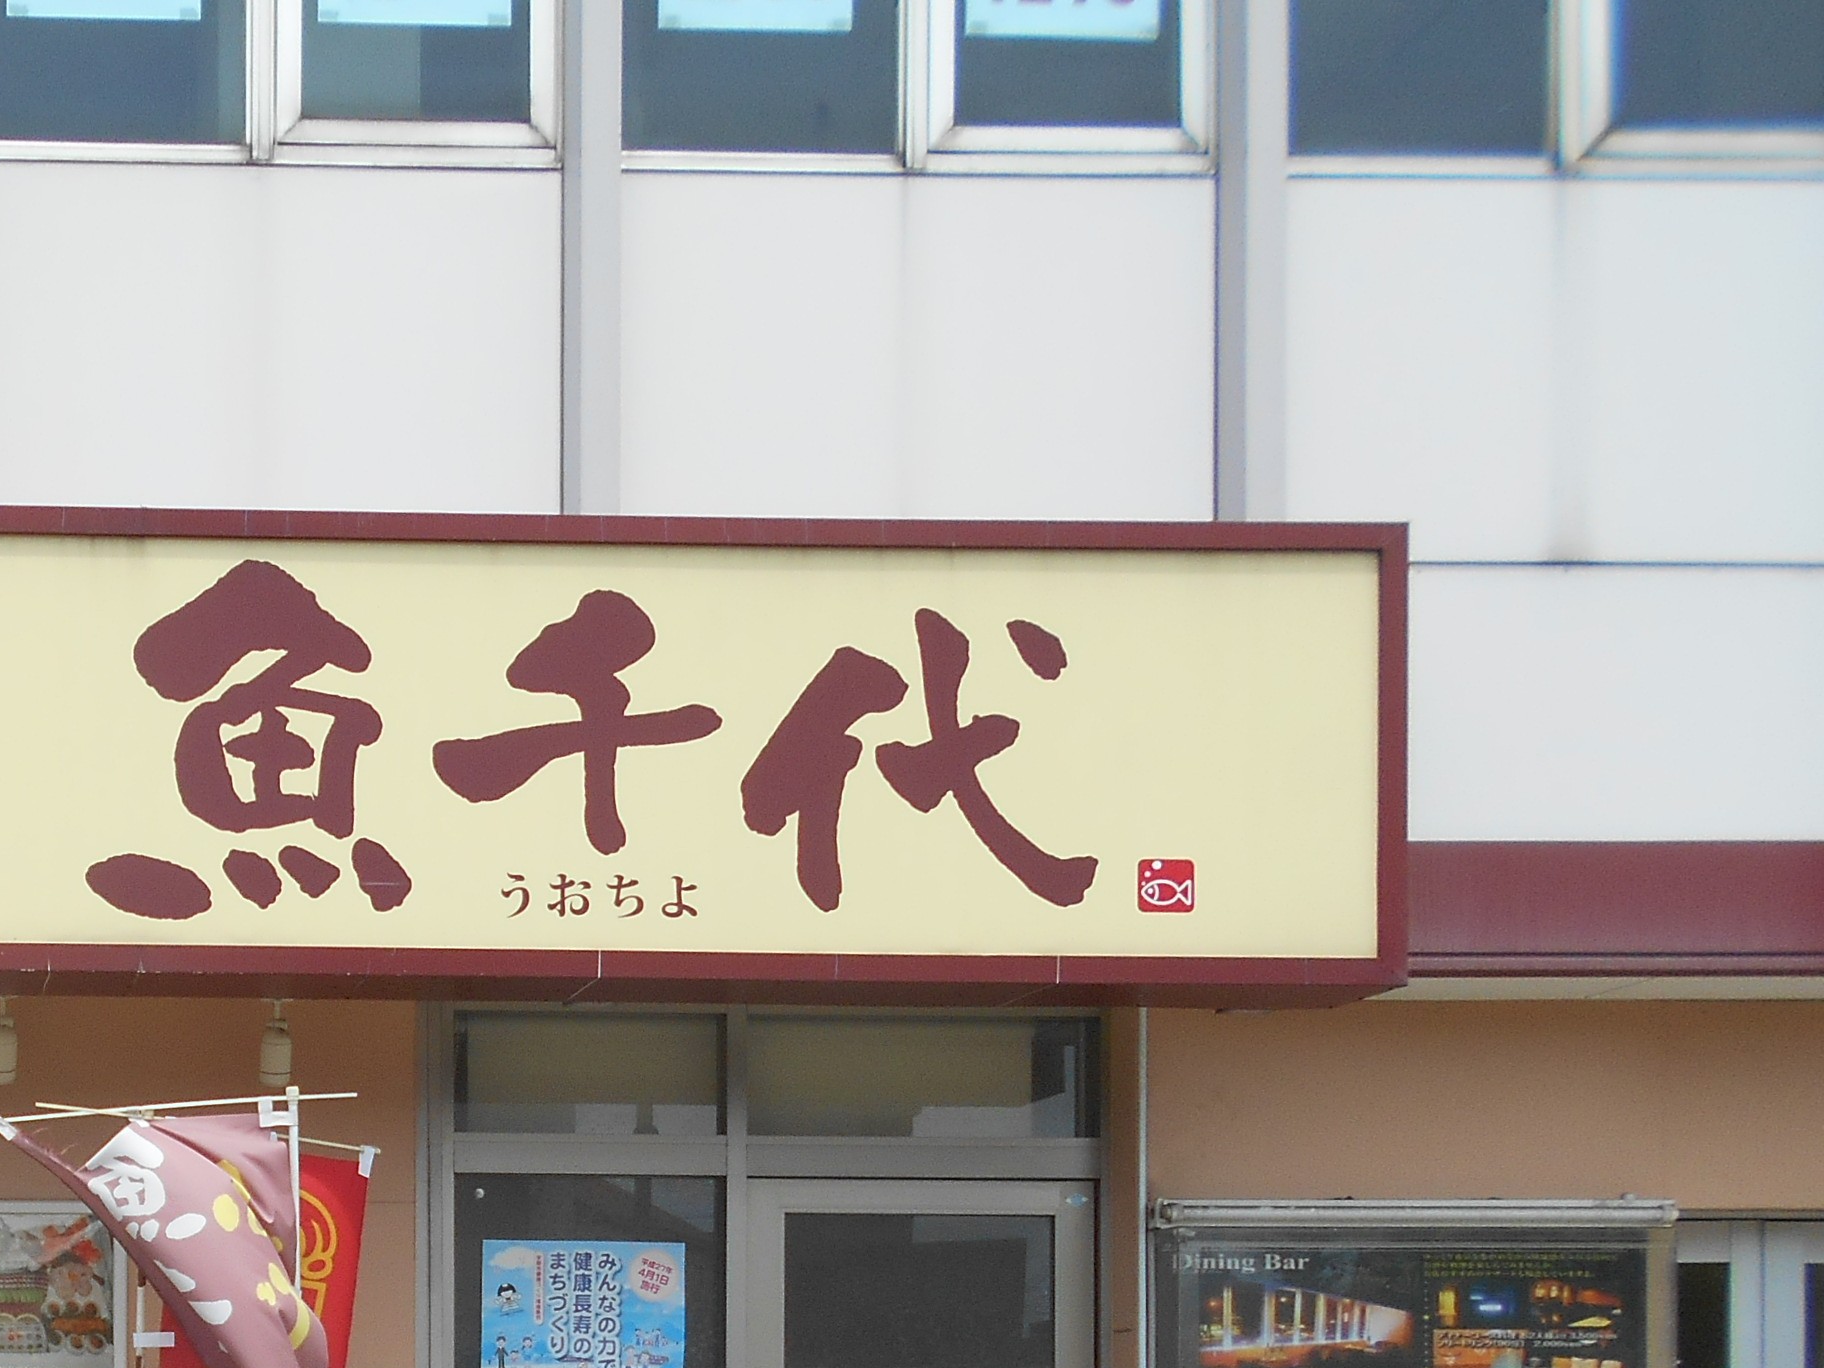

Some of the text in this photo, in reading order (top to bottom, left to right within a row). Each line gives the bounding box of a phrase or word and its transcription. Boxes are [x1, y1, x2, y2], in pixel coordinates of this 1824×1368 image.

[85, 559, 1099, 921] 魚千代
[499, 871, 701, 919] うおちよ
[638, 1268, 670, 1286] 4月1日
[1172, 1253, 1310, 1274] Dining Bar
[548, 1252, 568, 1354] まちづくり
[572, 1251, 593, 1355] 健康長寿の
